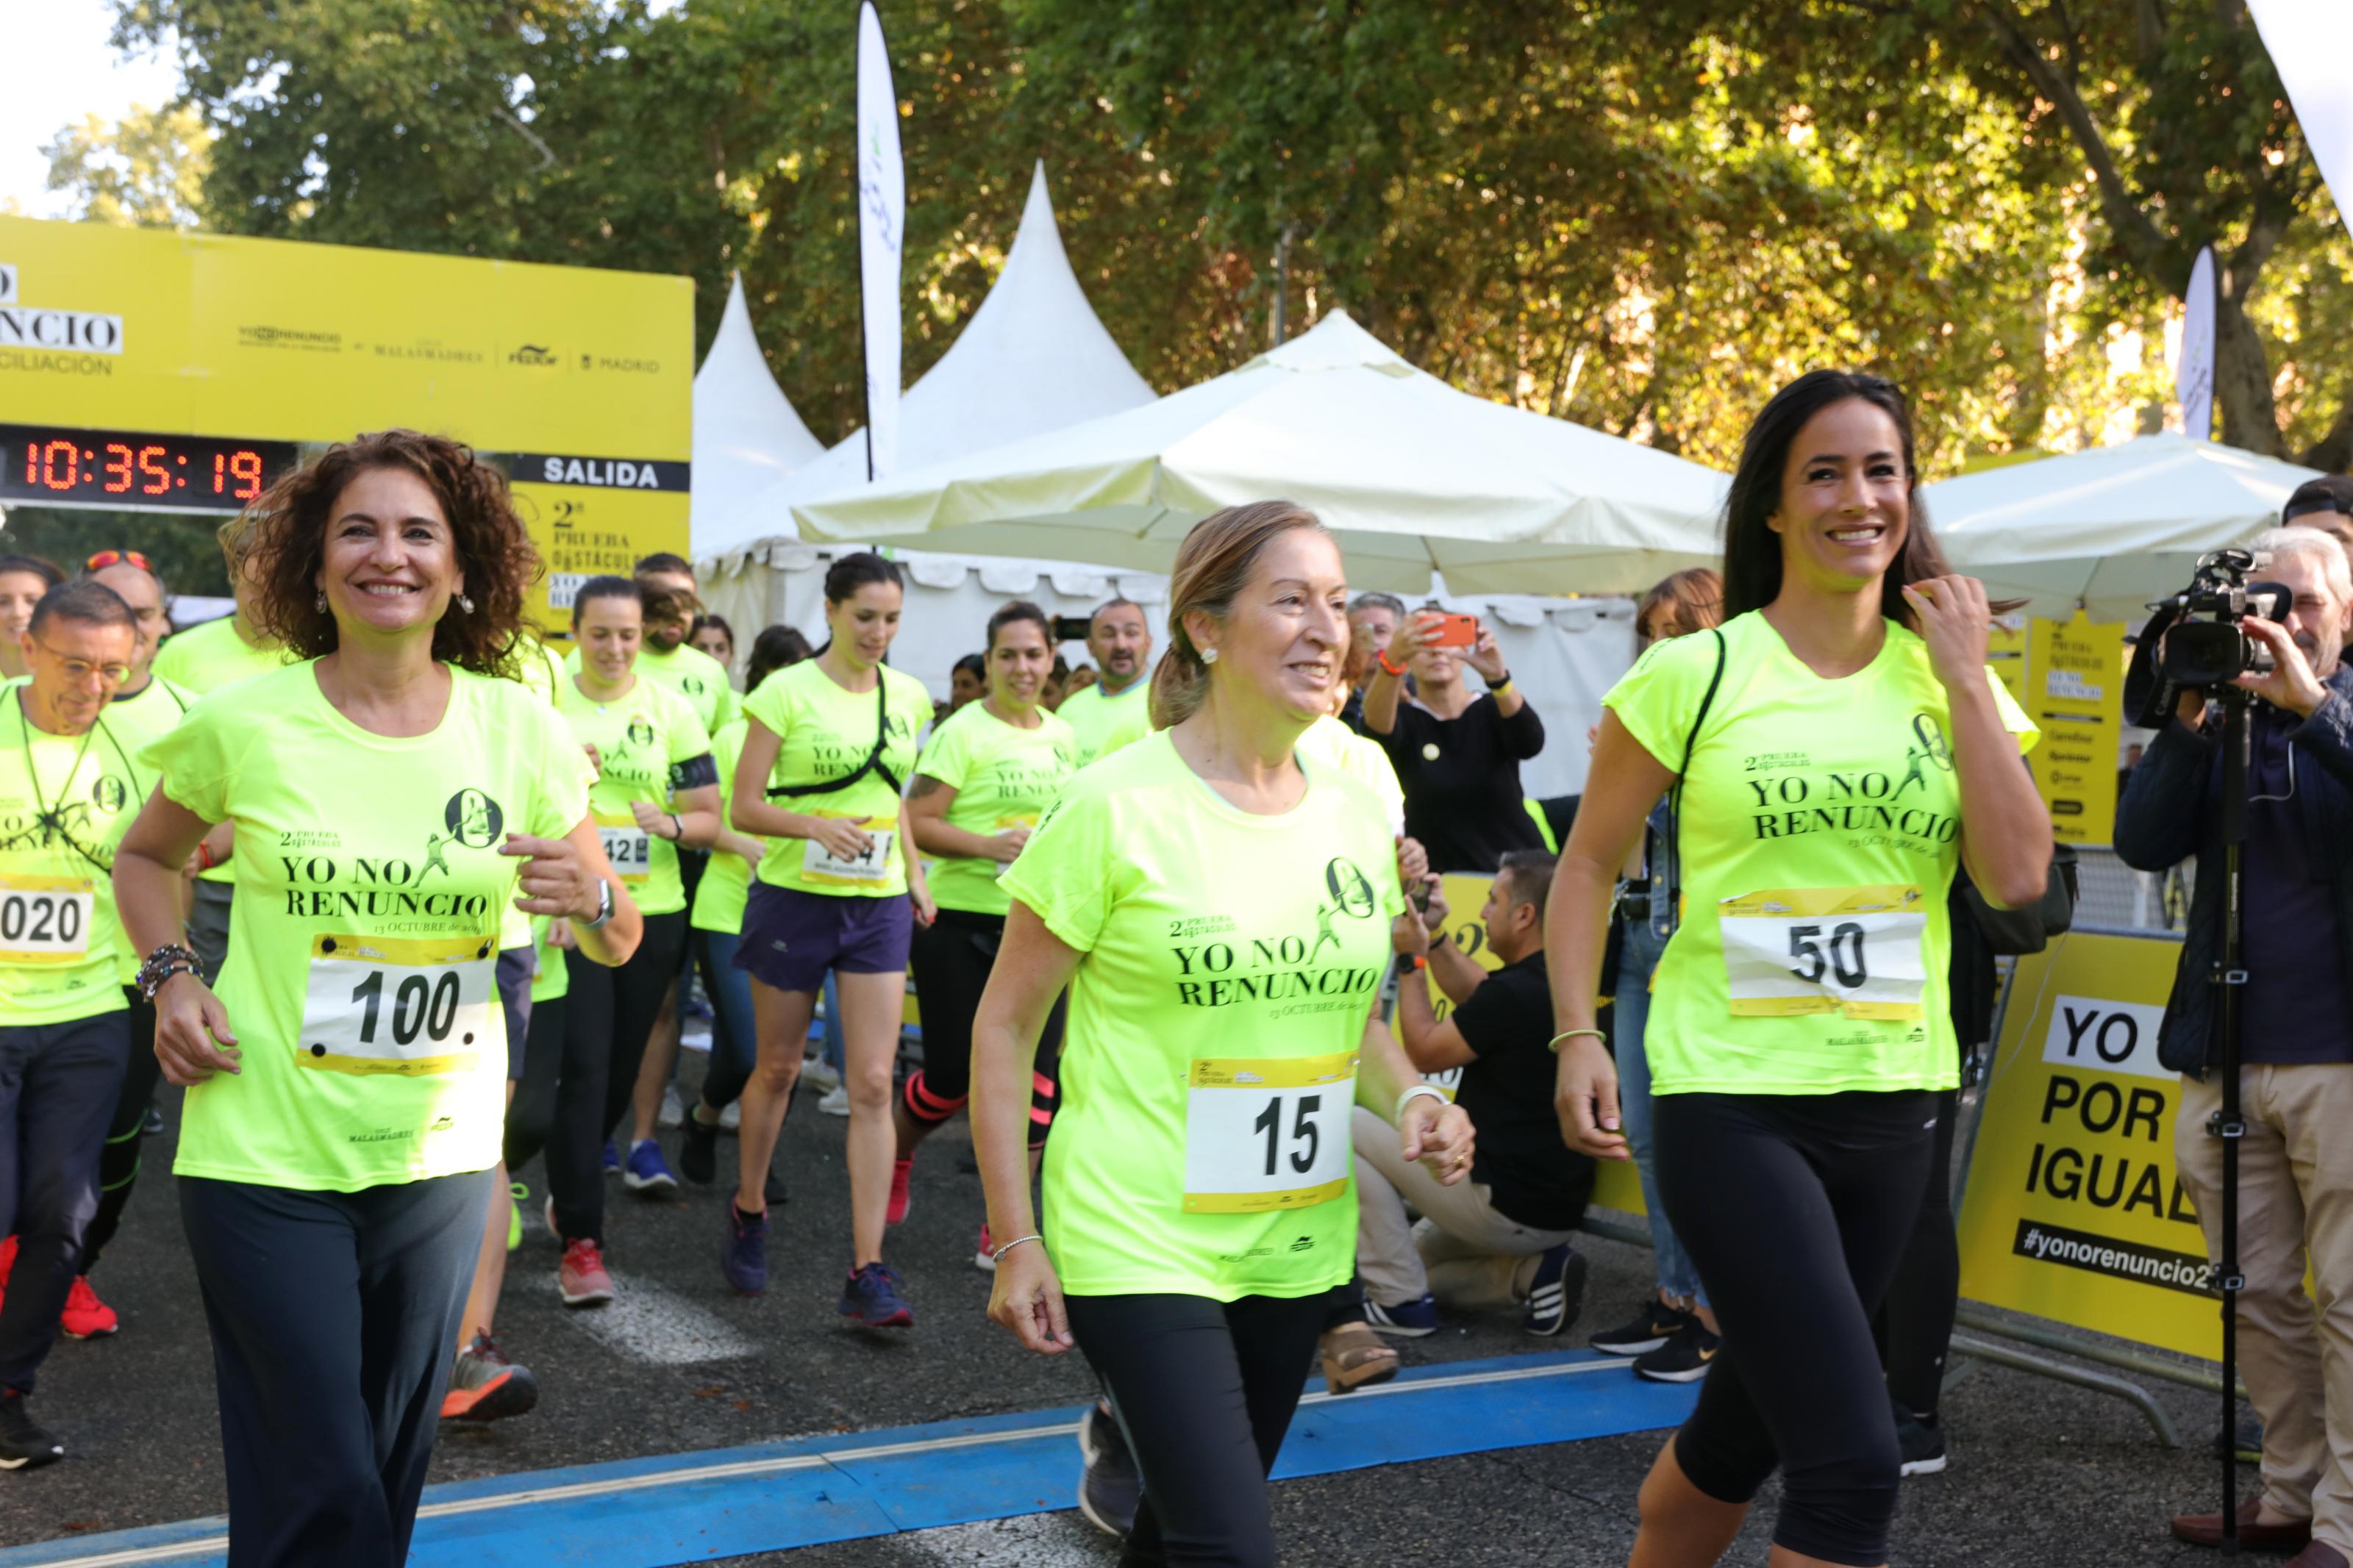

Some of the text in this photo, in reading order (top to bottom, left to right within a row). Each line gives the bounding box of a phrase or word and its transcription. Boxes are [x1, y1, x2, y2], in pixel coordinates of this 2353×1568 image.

[543, 457, 660, 489] SALIDA
[813, 745, 841, 761] YO
[1747, 772, 1890, 807] YO NO
[1751, 806, 1958, 844] RENUNCIO
[280, 856, 412, 886] YO NO
[1, 895, 81, 942] 020
[285, 889, 488, 919] RENUNCIO
[388, 922, 446, 933] OCTUBRE
[1171, 935, 1305, 975] YO NO
[1788, 922, 1867, 989] 50
[1174, 967, 1378, 1007] RENUNCIO
[351, 970, 460, 1046] 100
[2063, 1006, 2138, 1064] YO
[2040, 1074, 2165, 1142] POR
[1253, 1094, 1323, 1177] 15
[2025, 1143, 2199, 1225] IGUAL
